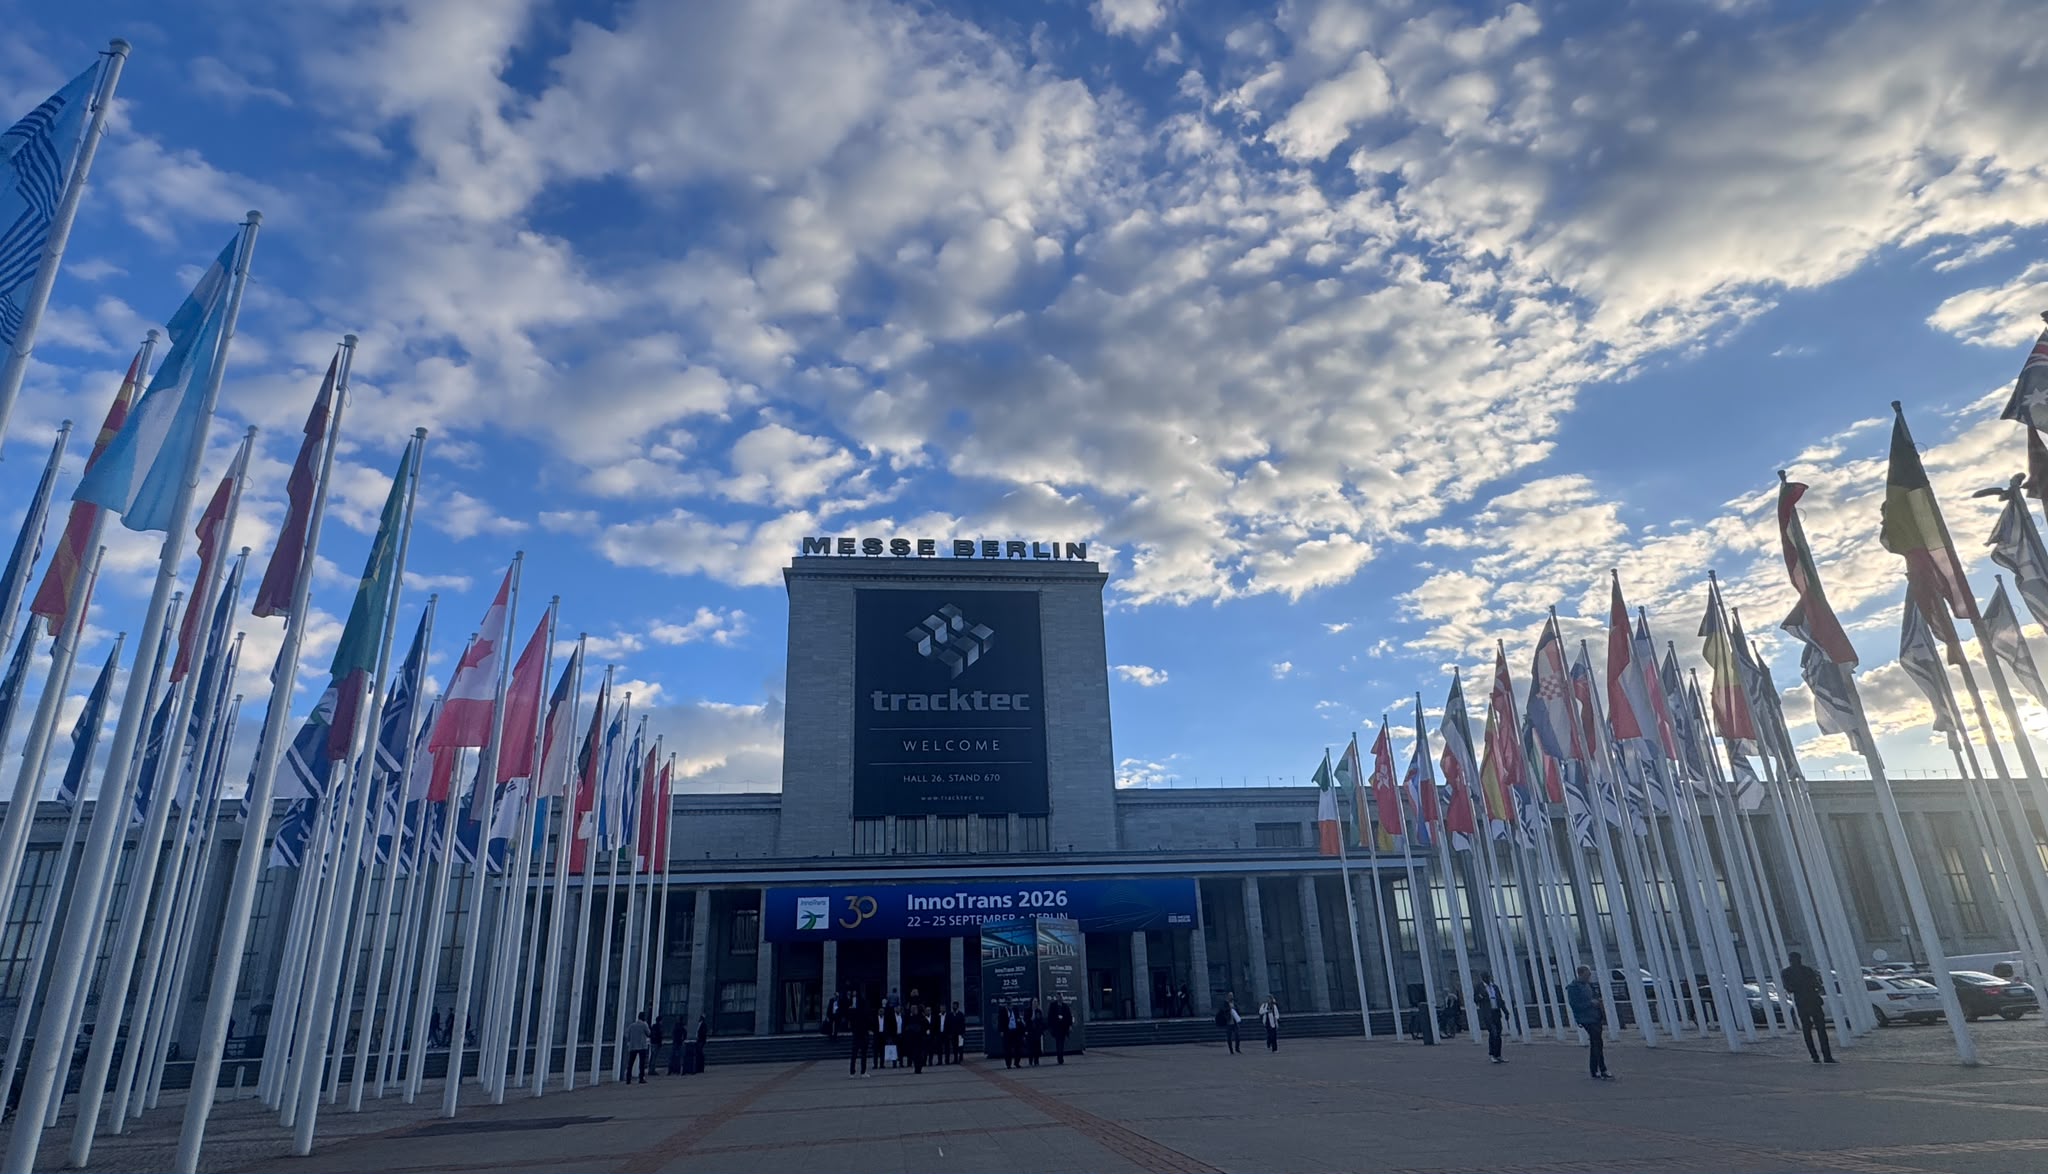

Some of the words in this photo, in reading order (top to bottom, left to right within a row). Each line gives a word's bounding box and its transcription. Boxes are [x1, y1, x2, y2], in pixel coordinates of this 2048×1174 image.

[802, 536, 936, 557] MESSE
[953, 539, 1087, 560] BERLIN
[870, 688, 1030, 711] tracktec
[902, 739, 1000, 752] WELCOME
[903, 774, 928, 783] HALL
[948, 773, 981, 783] STAND
[984, 773, 1000, 782] 670
[907, 893, 1013, 911] InnoTrans
[1018, 890, 1068, 908] 2026
[907, 916, 921, 927] 22
[932, 915, 946, 926] 25
[992, 944, 1029, 959] ITALIA
